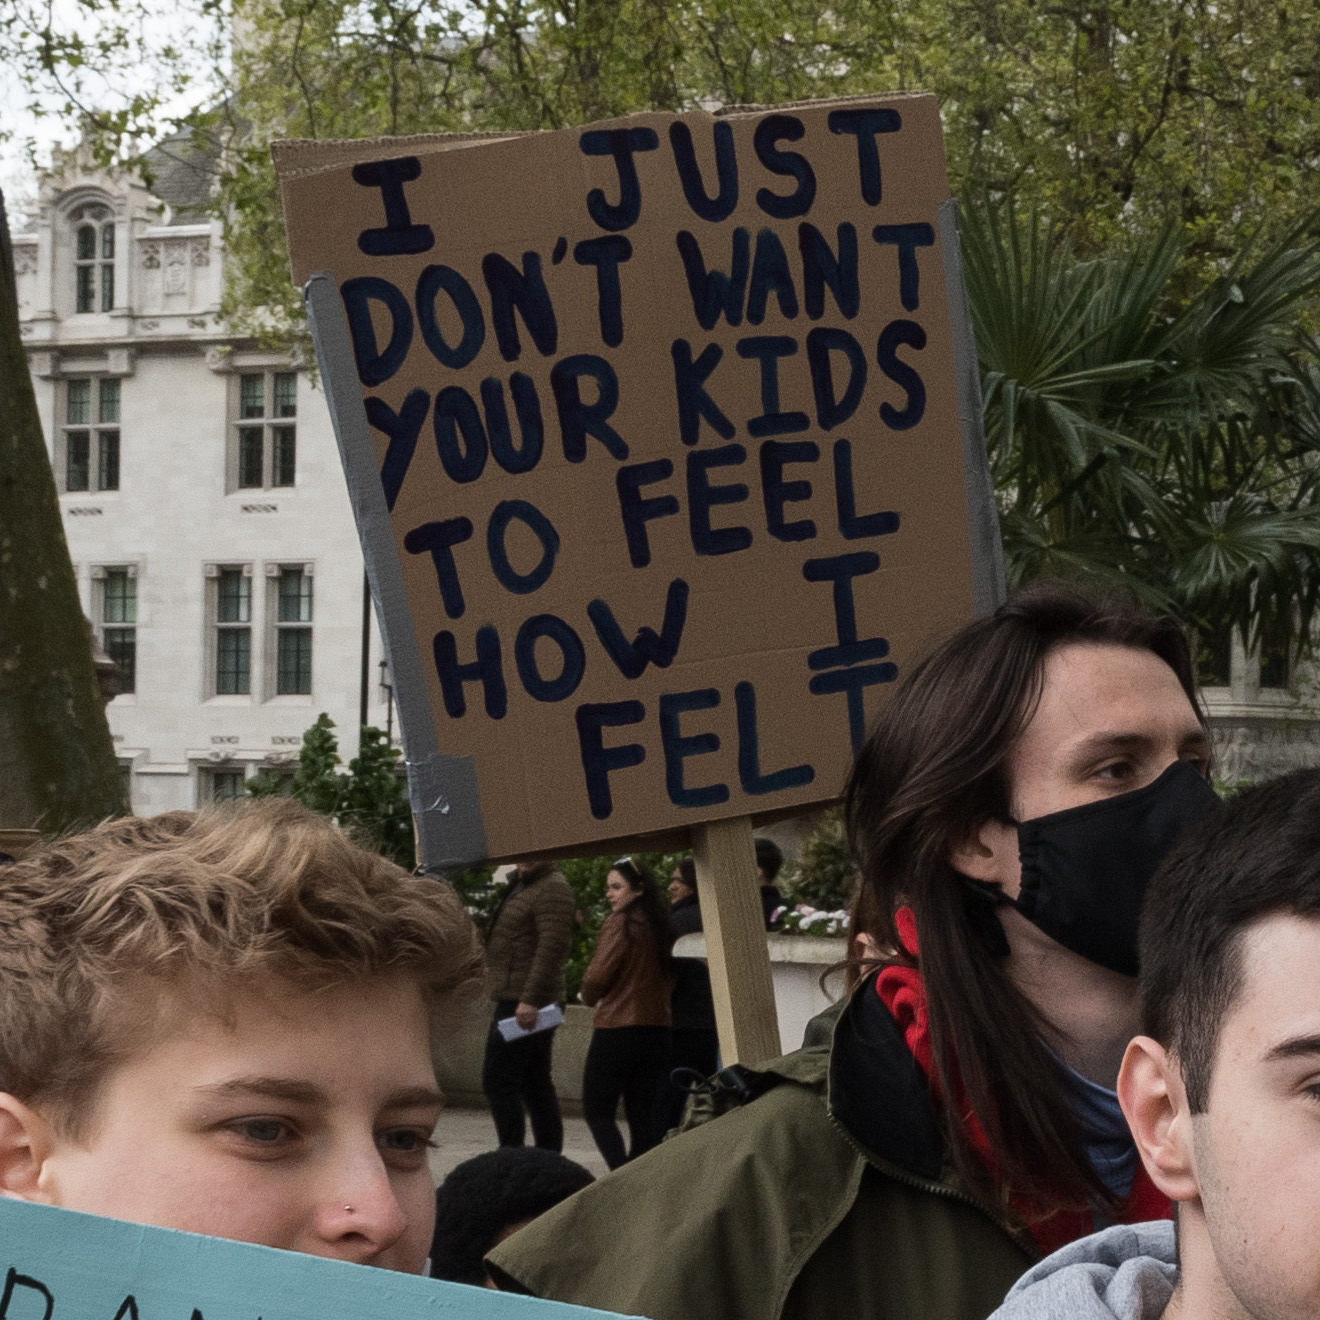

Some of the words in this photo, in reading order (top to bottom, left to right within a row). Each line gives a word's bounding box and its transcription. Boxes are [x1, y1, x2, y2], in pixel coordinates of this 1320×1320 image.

[352, 156, 436, 257] I
[579, 107, 903, 233] JUST
[340, 233, 633, 389] DON'T
[676, 221, 937, 332] WANT
[364, 354, 630, 514] YOUR
[670, 319, 928, 447] KIDS
[403, 500, 561, 620] TO
[615, 438, 902, 570] FEEL
[432, 578, 690, 721] HOW
[802, 552, 890, 669] I
[574, 661, 899, 821] FELT
